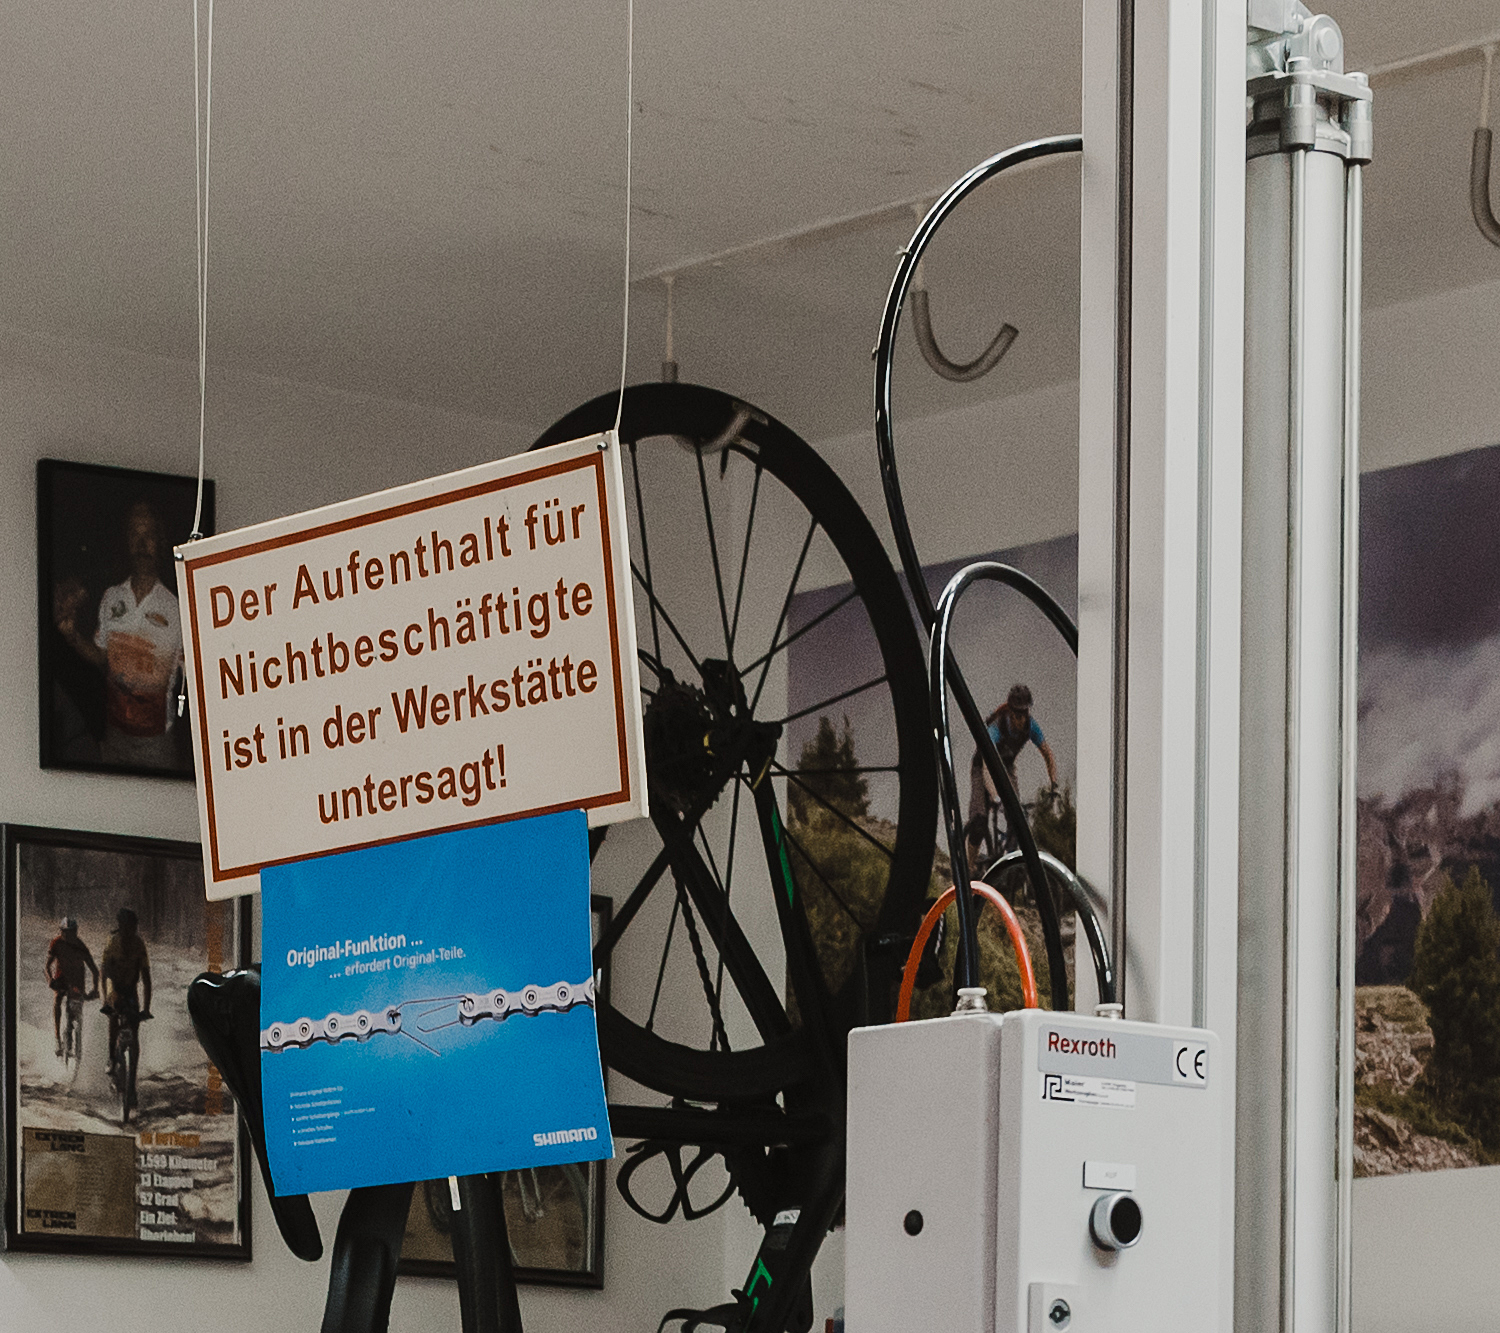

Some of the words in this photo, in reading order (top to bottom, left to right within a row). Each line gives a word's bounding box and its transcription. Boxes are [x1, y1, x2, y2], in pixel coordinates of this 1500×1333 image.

[209, 582, 278, 629] Der
[291, 513, 512, 610] Aufenthalt
[524, 498, 586, 550] für
[218, 576, 593, 700] Nichtbeschäftigte
[222, 723, 267, 771] ist
[277, 717, 310, 760] in
[322, 705, 382, 750] der
[390, 653, 599, 734] Werkstätte
[317, 743, 508, 825] untersagt!
[286, 932, 407, 968] Original-Funktion
[344, 956, 391, 976] erfordert
[393, 946, 467, 969] Original-Teile.
[1048, 1031, 1117, 1059] Rexroth
[533, 1126, 597, 1147] SHIMANO
[155, 1193, 179, 1208] Grad
